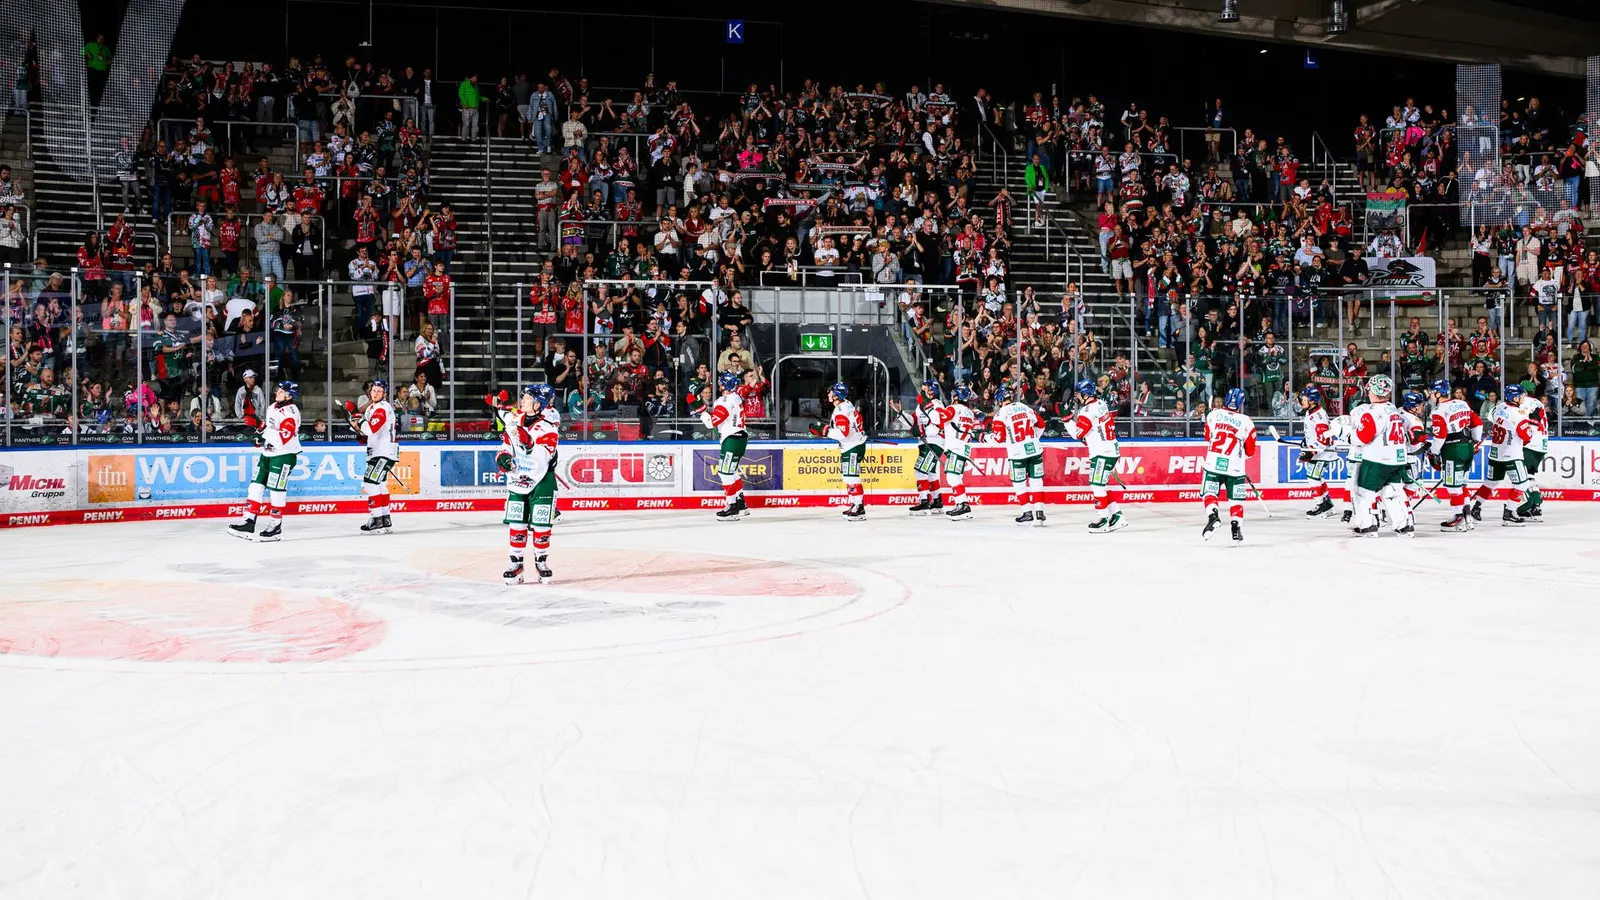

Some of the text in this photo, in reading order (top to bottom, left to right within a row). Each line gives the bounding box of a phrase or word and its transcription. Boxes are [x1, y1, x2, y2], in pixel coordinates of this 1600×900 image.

[729, 23, 742, 39] K
[1307, 49, 1316, 64] L
[1363, 269, 1425, 288] PANTHER
[1013, 419, 1035, 442] 54
[1211, 431, 1238, 456] 27
[570, 453, 644, 483] GTÜ
[710, 464, 767, 476] WTER
[798, 464, 826, 474] BÜRO
[861, 466, 902, 474] EWERBE
[1064, 456, 1145, 475] PENY.
[97, 464, 127, 486] tfm
[31, 491, 65, 499] Gruppe
[1123, 492, 1155, 500] PENNY.
[436, 500, 474, 510] PENNY.
[572, 500, 610, 508] PENNY.
[637, 499, 674, 508] PENNY.
[765, 497, 800, 506] PENNY.
[156, 508, 197, 518] PENNY.
[298, 503, 338, 512] PENNY.
[8, 514, 51, 526] PENNY.
[83, 511, 125, 521] PENNY.
